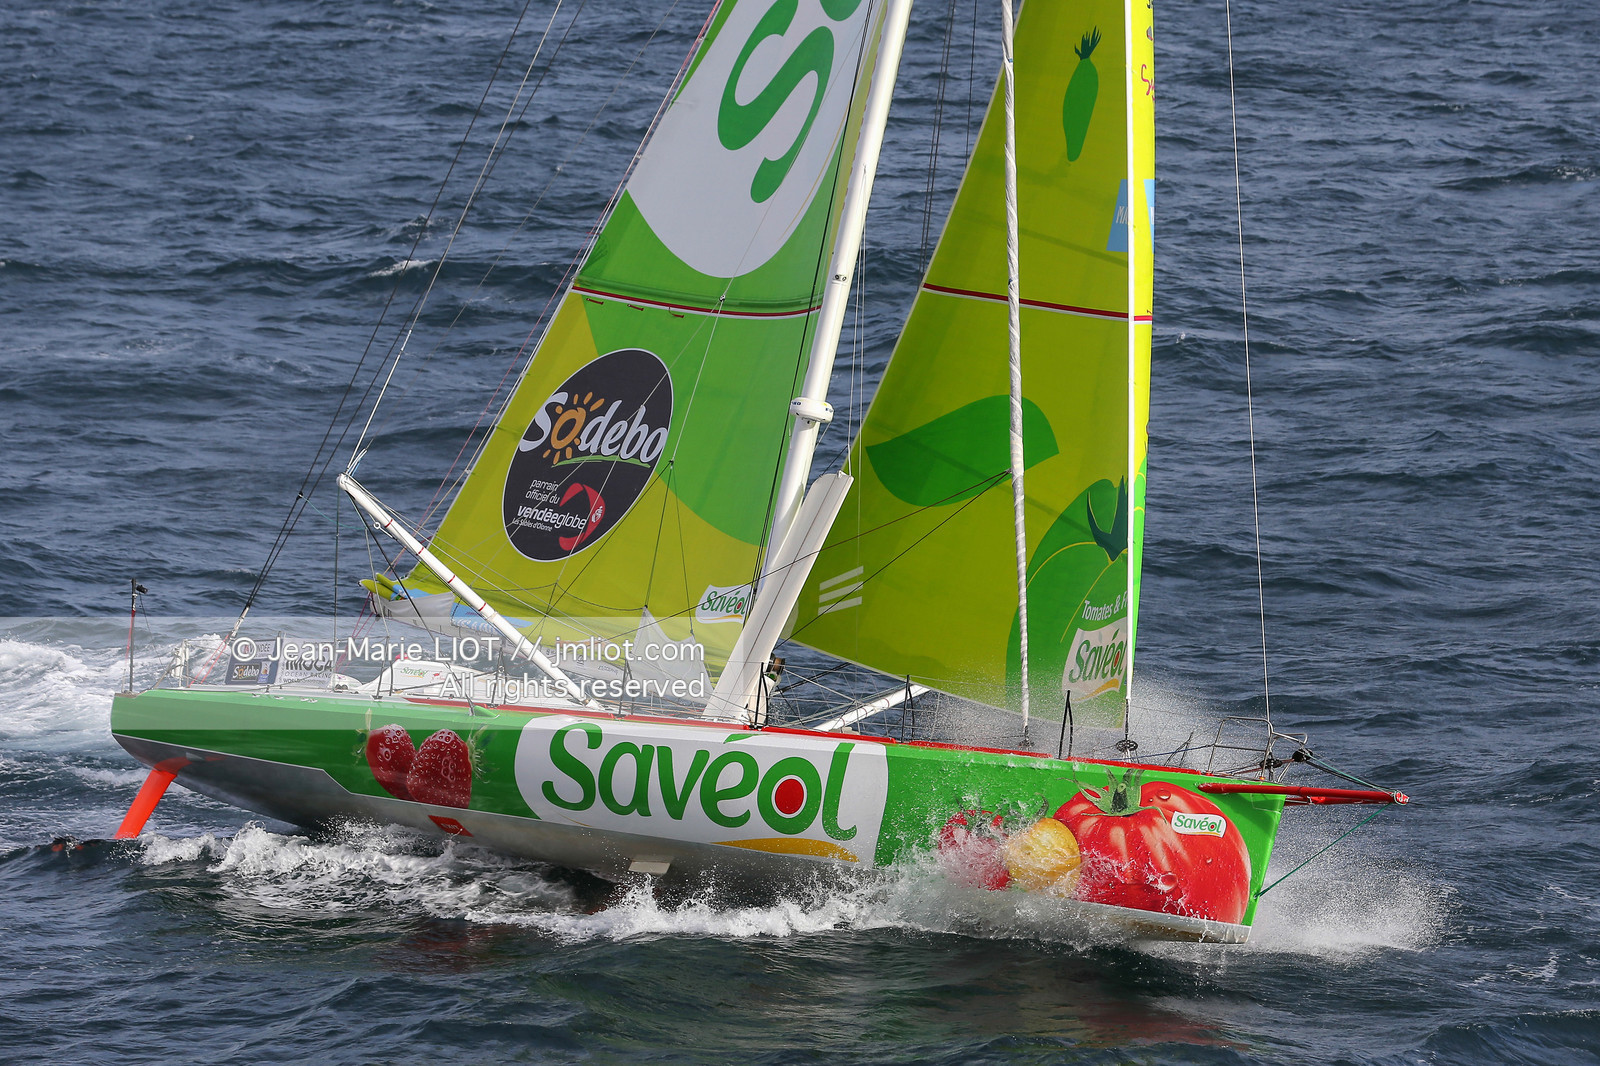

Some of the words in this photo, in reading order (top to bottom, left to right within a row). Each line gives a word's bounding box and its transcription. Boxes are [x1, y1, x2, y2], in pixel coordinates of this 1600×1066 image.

[519, 391, 668, 463] Sodebo
[525, 487, 550, 502] officiel
[549, 493, 560, 504] du
[529, 479, 559, 492] parrain
[701, 590, 751, 615] Savéol
[1082, 599, 1114, 621] Tomates
[1113, 594, 1121, 615] &
[285, 655, 333, 671] IMOCA
[1069, 628, 1127, 683] Savéol
[232, 665, 260, 679] Sodebo
[541, 723, 857, 841] Savéol
[1174, 814, 1222, 833] Savéol
